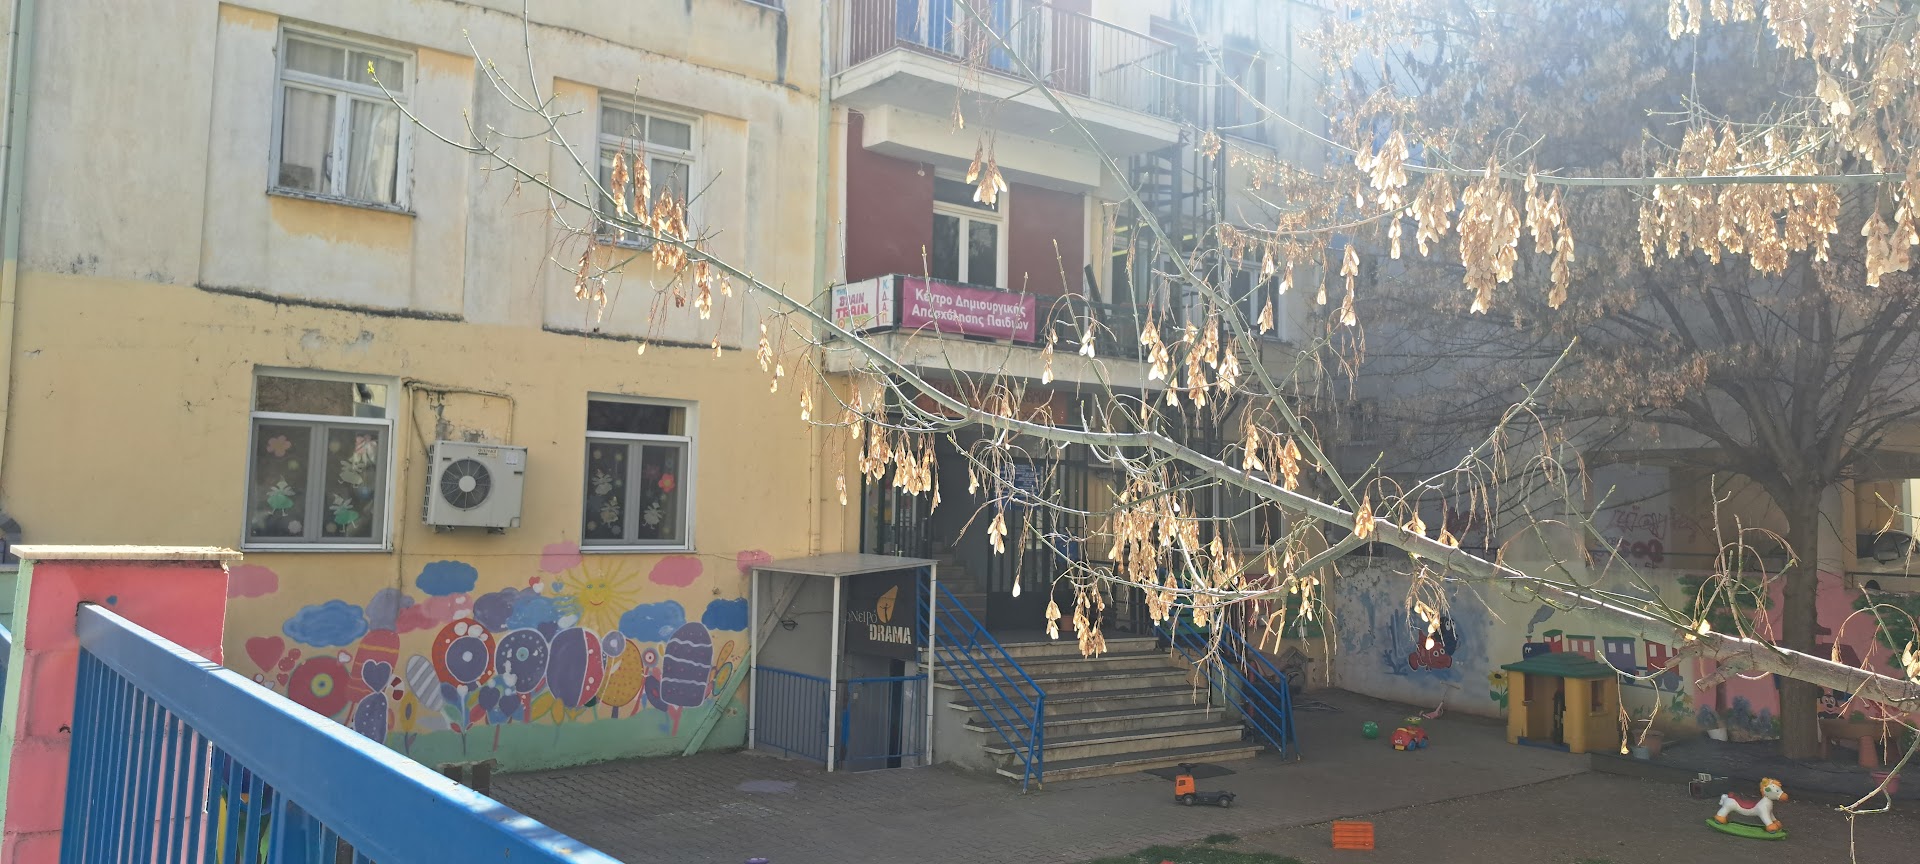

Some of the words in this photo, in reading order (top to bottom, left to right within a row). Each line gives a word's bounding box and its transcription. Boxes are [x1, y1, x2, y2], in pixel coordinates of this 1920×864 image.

[835, 303, 869, 319] TRAIN
[911, 303, 985, 328] Απασχόλησης
[987, 314, 1030, 331] Παιδιών
[955, 294, 1027, 318] Δημιουργικής
[869, 623, 912, 645] DRAMA
